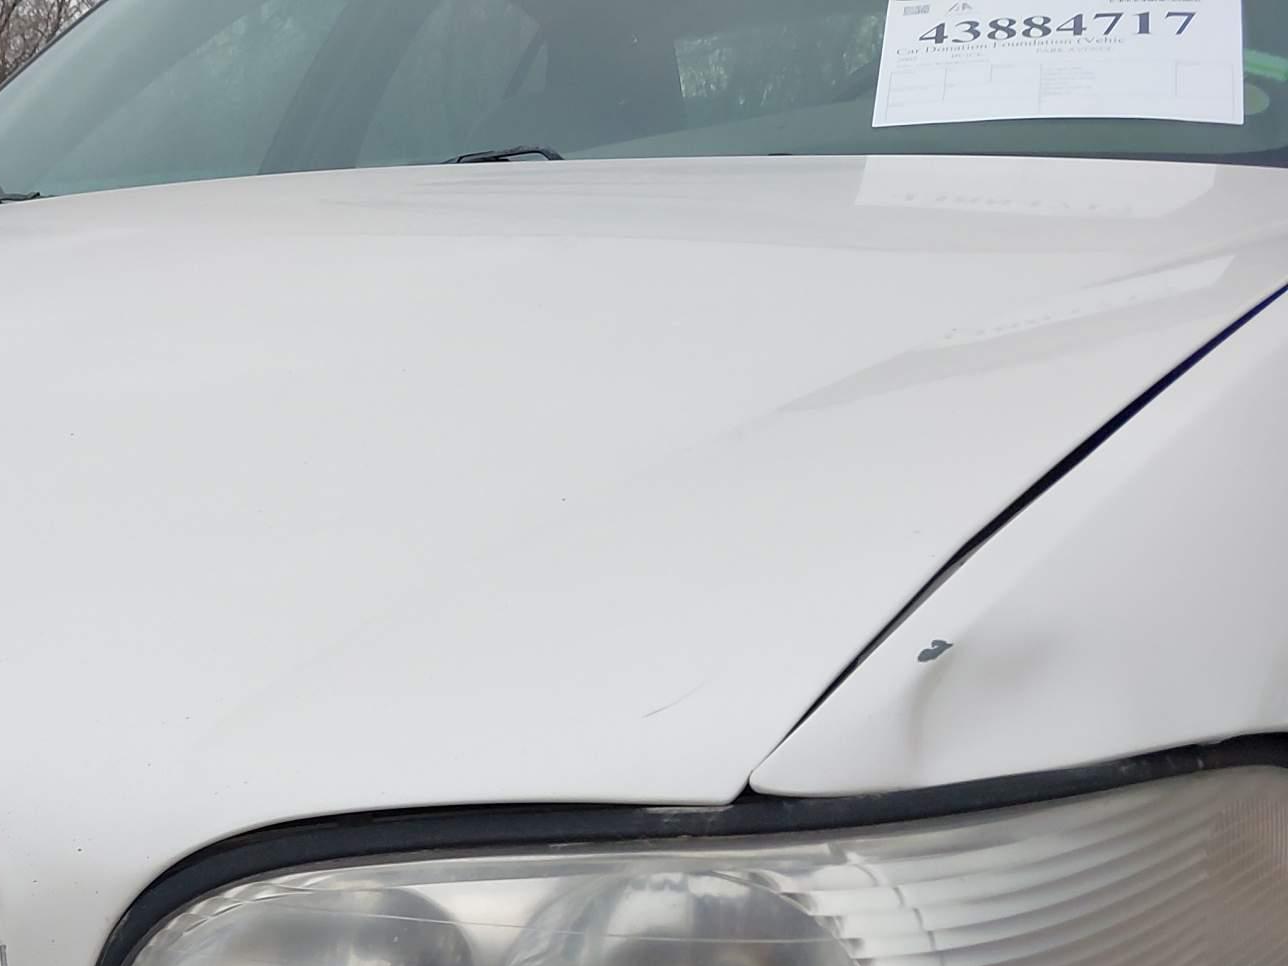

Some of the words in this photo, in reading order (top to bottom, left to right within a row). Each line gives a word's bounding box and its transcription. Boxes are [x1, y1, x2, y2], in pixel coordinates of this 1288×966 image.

[918, 11, 1197, 45] 43884717
[895, 47, 919, 56] Car
[925, 43, 988, 54] Donation
[993, 38, 1072, 49] Foundation
